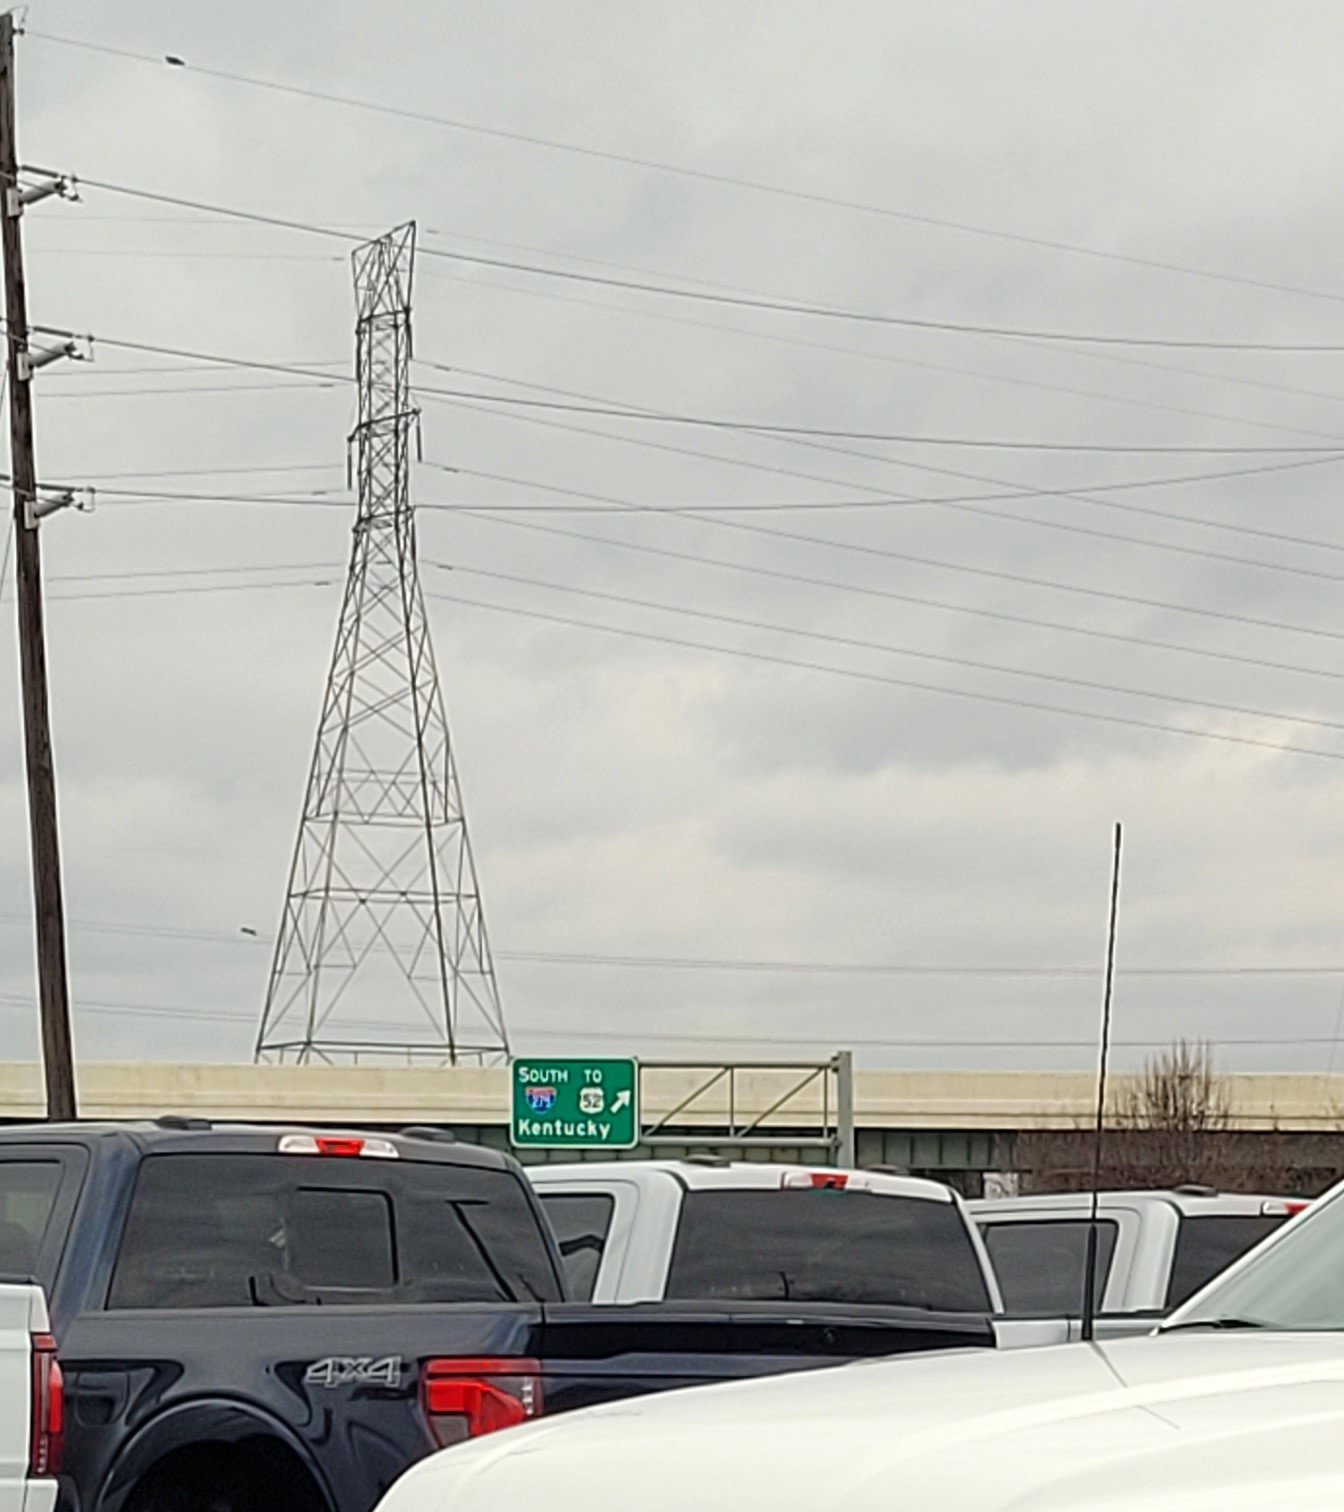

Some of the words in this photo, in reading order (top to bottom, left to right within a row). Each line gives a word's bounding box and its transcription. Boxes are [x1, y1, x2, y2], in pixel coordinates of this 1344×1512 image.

[518, 1066, 569, 1083] SOUTH
[584, 1069, 602, 1083] TO
[583, 1093, 602, 1109] 52
[518, 1118, 611, 1141] Kentucky
